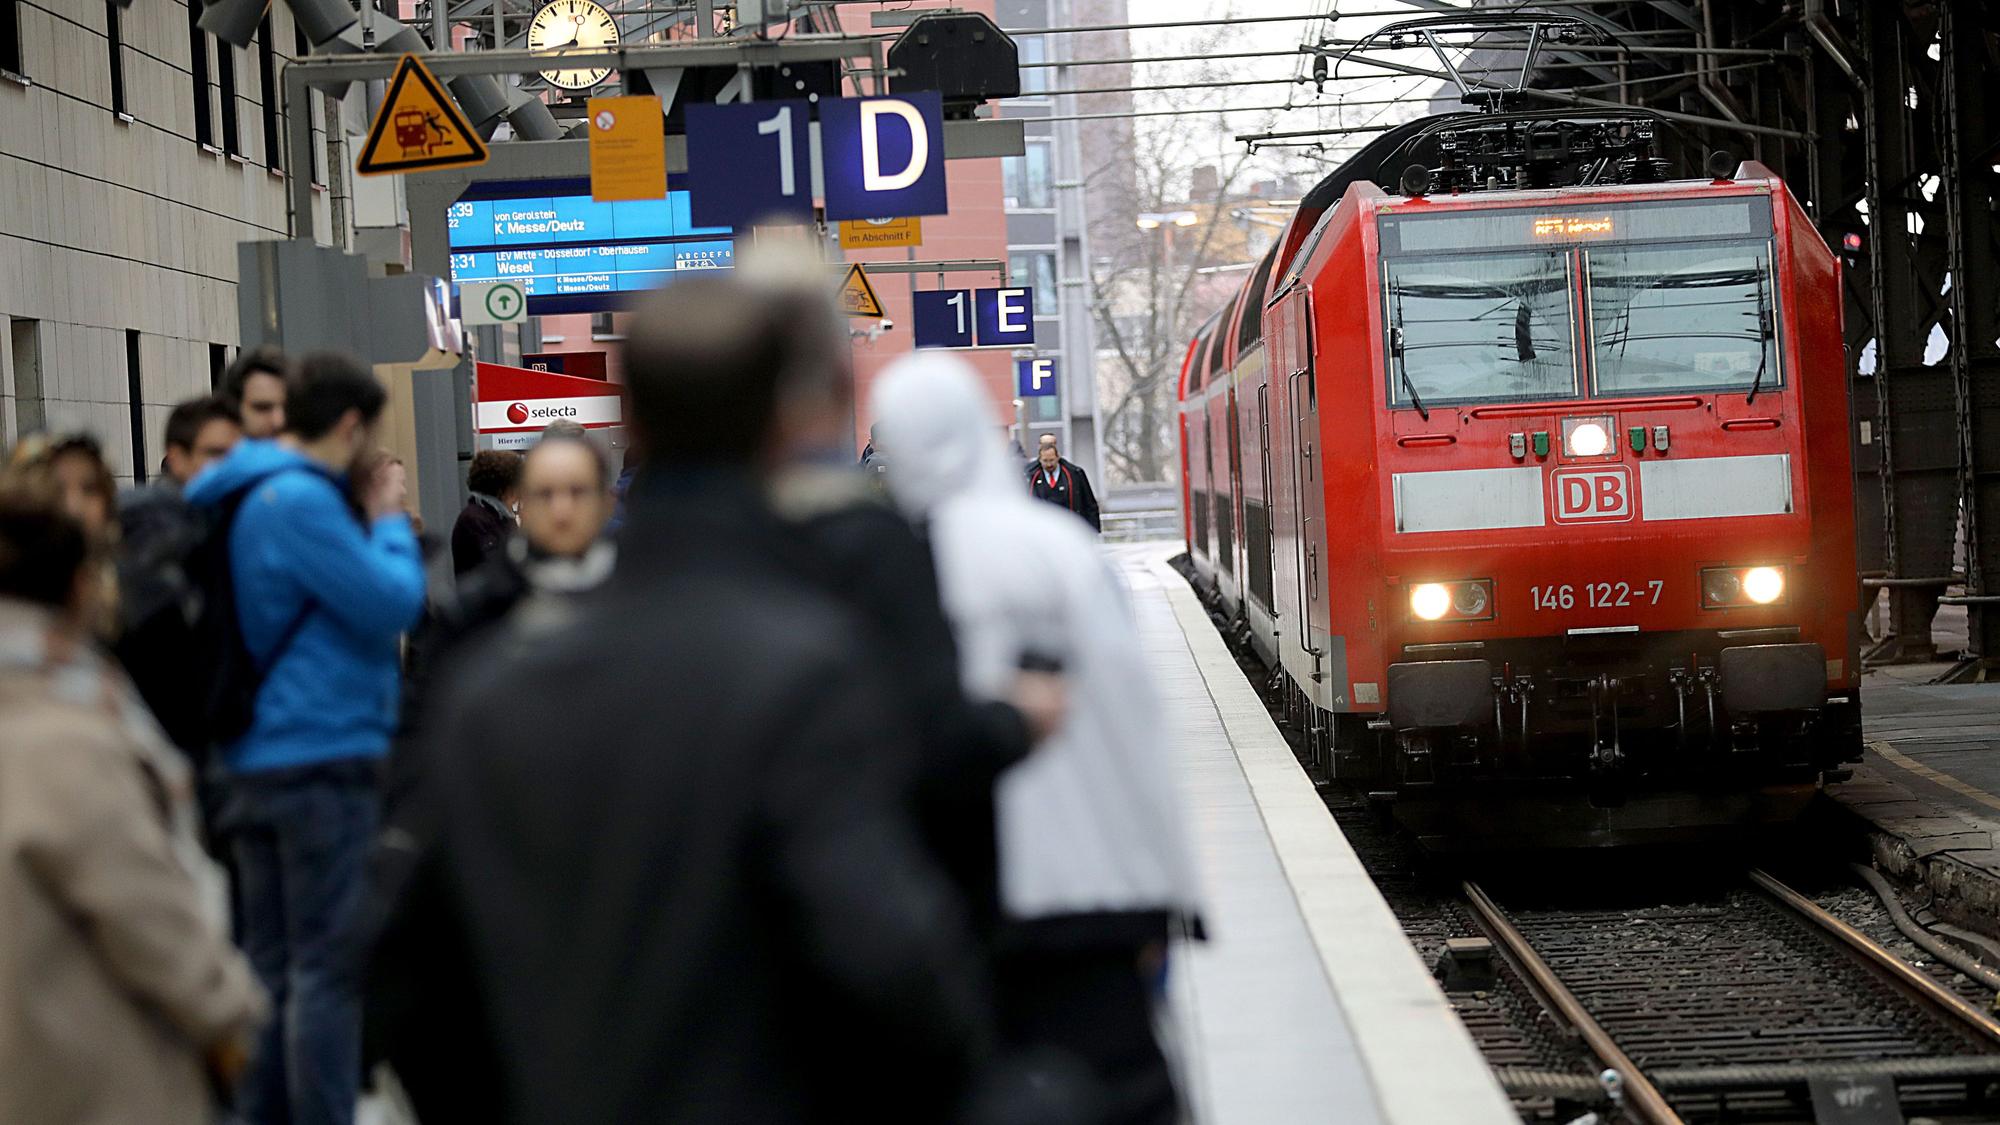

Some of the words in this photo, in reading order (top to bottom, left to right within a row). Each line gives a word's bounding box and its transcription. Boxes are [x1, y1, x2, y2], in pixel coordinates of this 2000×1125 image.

[758, 106, 795, 195] 1
[860, 99, 928, 191] D
[494, 213, 510, 221] von
[511, 210, 556, 220] Gerolstein
[494, 223, 503, 235] K
[507, 220, 585, 234] Messe/Deutz
[849, 234, 860, 242] im
[863, 232, 903, 241] Abschnitt
[906, 231, 911, 240] F
[496, 251, 511, 261] LEV
[513, 250, 536, 260] Mitte
[544, 247, 590, 259] Düsseldorf
[599, 246, 649, 256] Oberhausen
[497, 261, 534, 274] Wesel
[947, 292, 965, 333] 1
[998, 289, 1027, 332] E
[1032, 360, 1052, 390] F
[532, 406, 577, 418] selecta
[498, 437, 513, 445] Hier
[1562, 475, 1624, 514] DB
[1531, 585, 1575, 610] 146
[1586, 580, 1664, 608] 122-7
